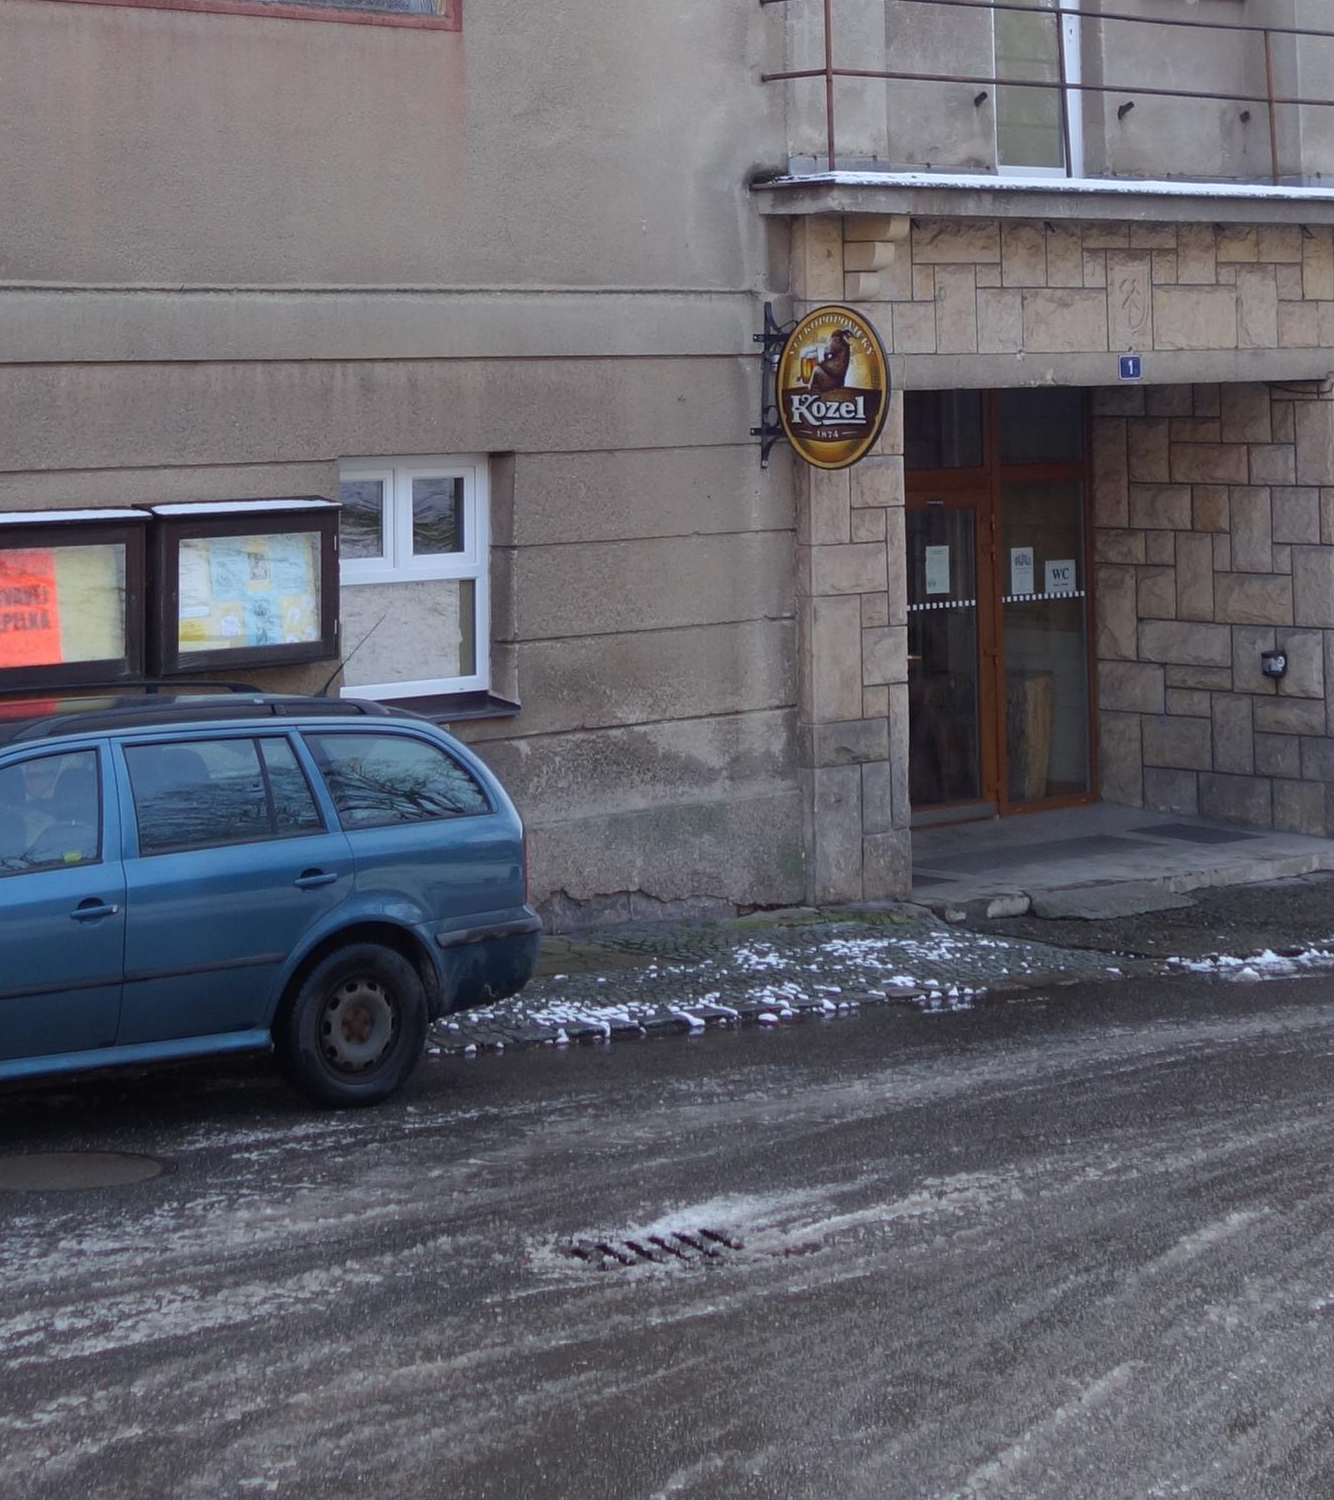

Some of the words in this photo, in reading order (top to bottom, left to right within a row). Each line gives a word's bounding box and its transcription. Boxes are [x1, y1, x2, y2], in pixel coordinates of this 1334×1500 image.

[1128, 359, 1133, 375] 1
[791, 394, 867, 426] Kozel
[1052, 568, 1069, 580] WC
